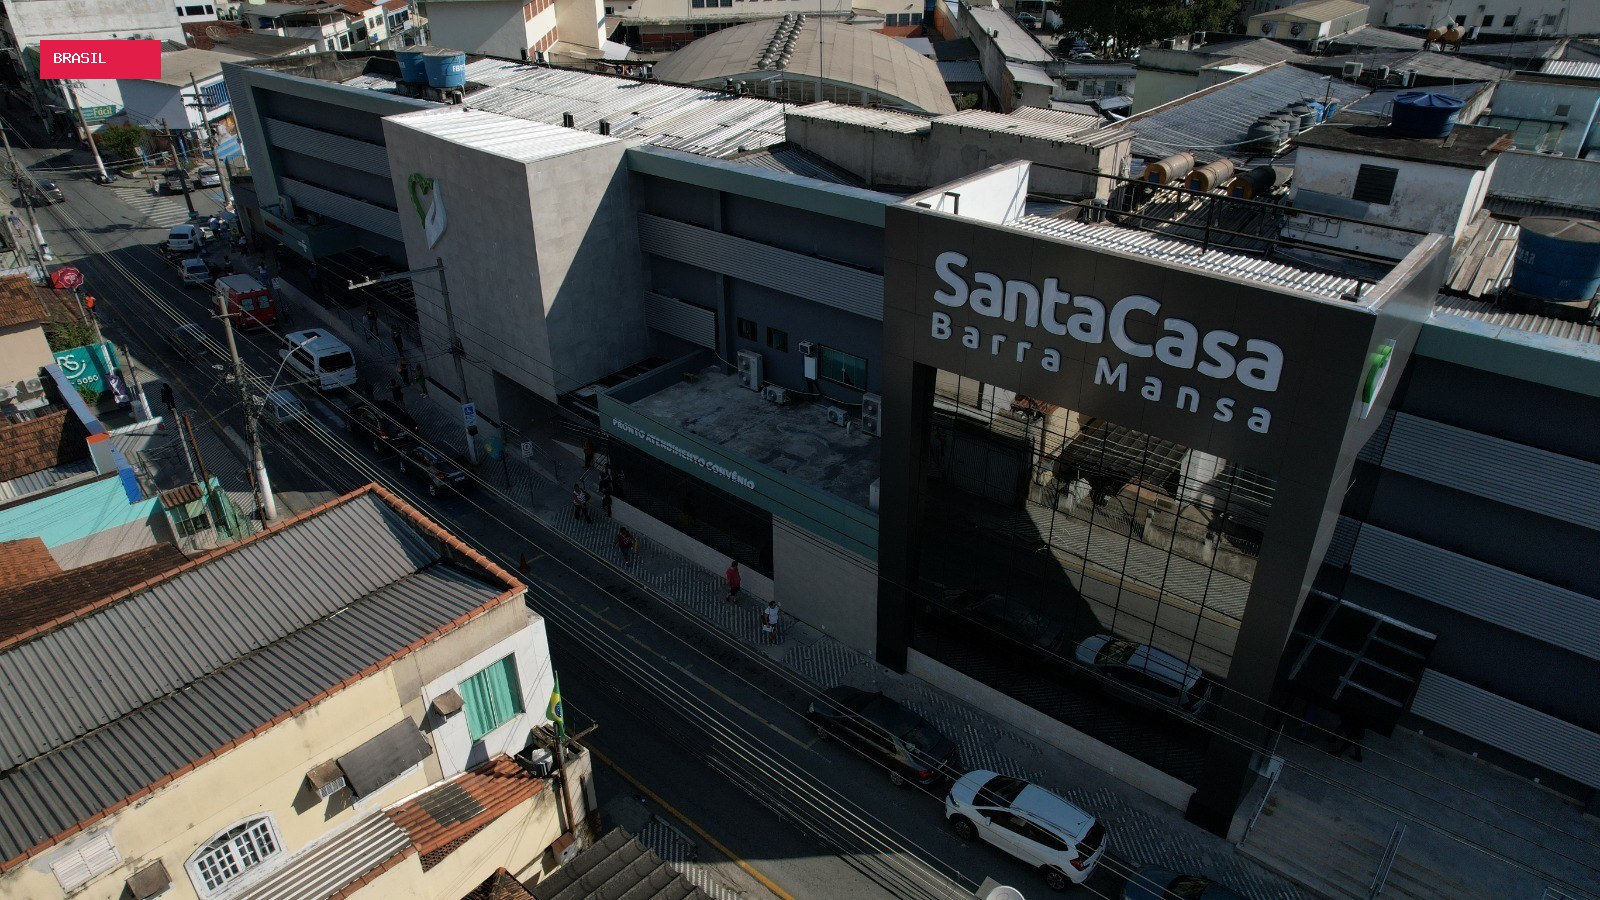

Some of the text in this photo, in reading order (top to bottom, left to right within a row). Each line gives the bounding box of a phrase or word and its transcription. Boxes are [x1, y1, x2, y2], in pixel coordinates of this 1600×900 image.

[931, 311, 1272, 434] Barra Mansa
[612, 417, 756, 490] PRONTO ATENDIMENTO CONVÊNIO
